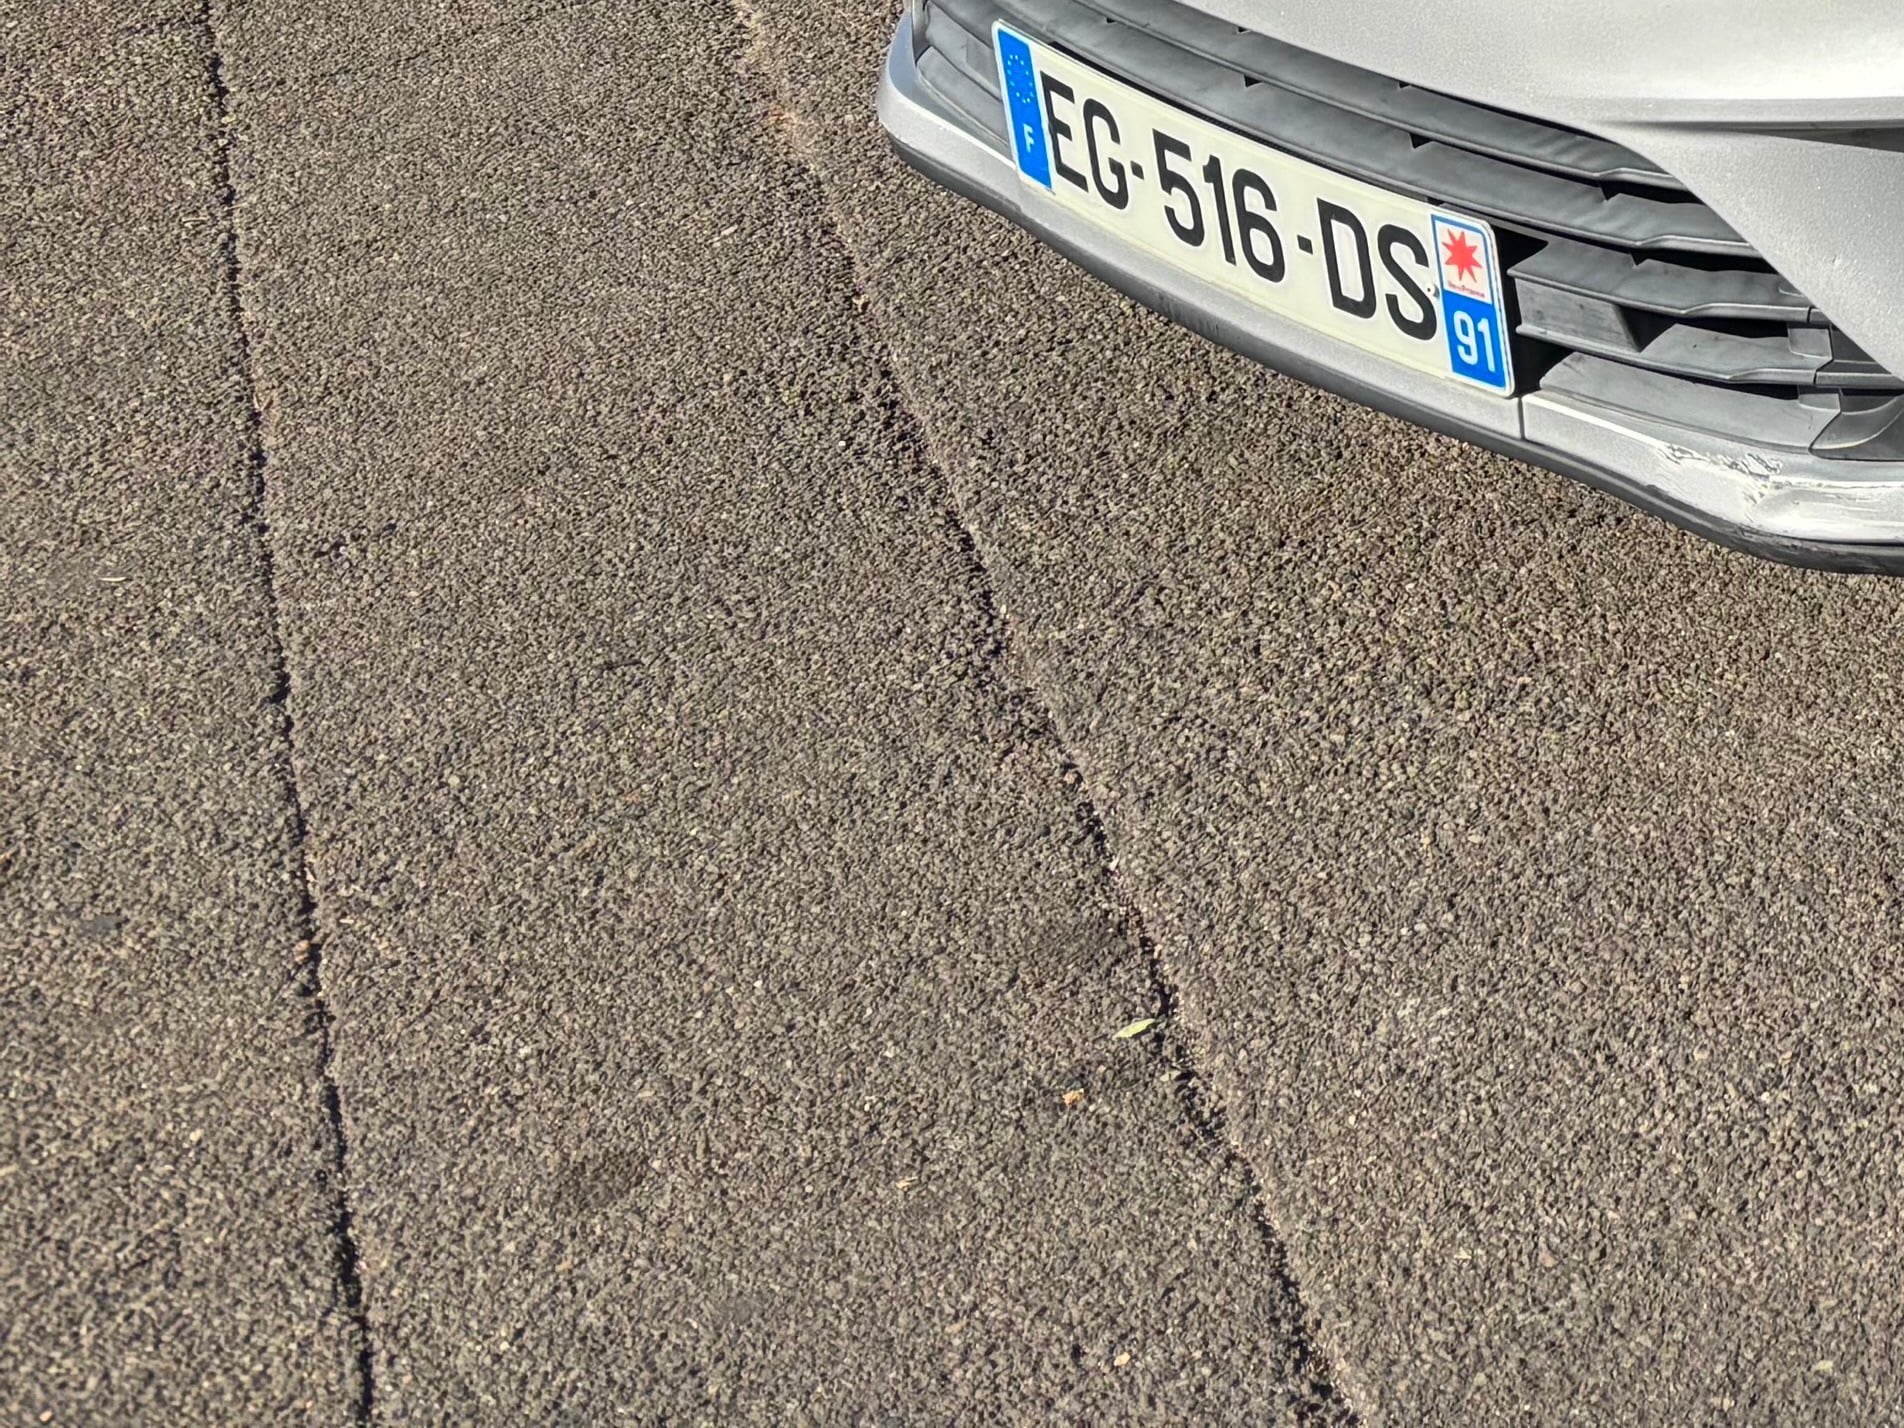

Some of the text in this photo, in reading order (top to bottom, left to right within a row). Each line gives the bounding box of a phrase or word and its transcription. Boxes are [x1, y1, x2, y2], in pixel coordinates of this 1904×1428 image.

[1022, 122, 1035, 153] F
[1040, 70, 1437, 341] EG-516-DS
[1453, 310, 1496, 373] 91
